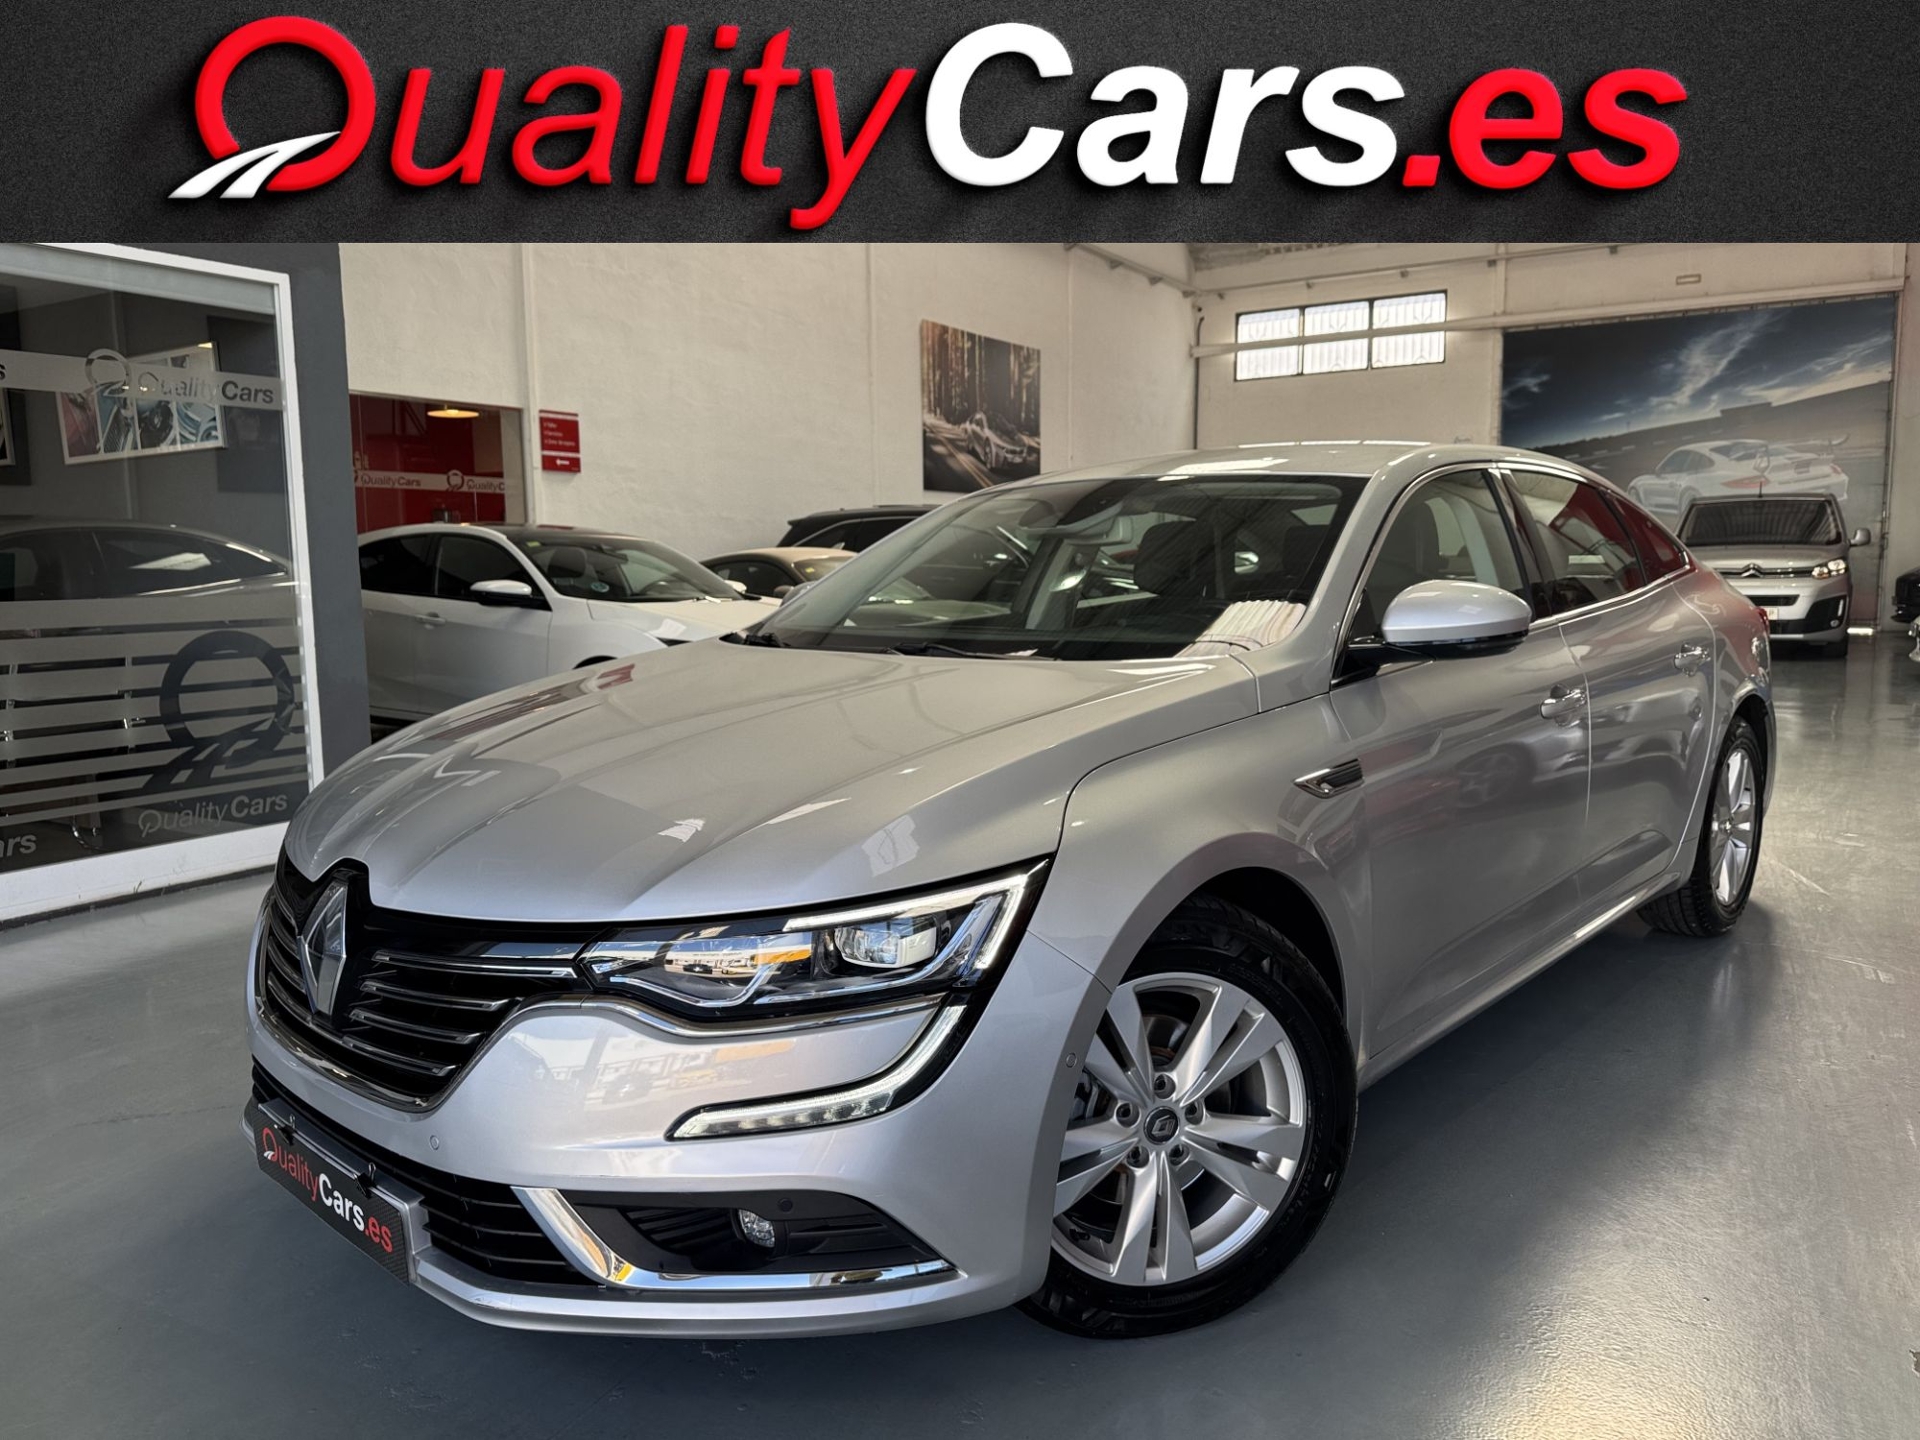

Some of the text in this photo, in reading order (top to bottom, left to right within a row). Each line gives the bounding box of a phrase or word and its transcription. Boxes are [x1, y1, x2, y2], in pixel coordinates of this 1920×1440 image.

[361, 473, 421, 488] QualityCars
[138, 793, 288, 838] QualityCars
[262, 1127, 393, 1253] QualityCars.es
